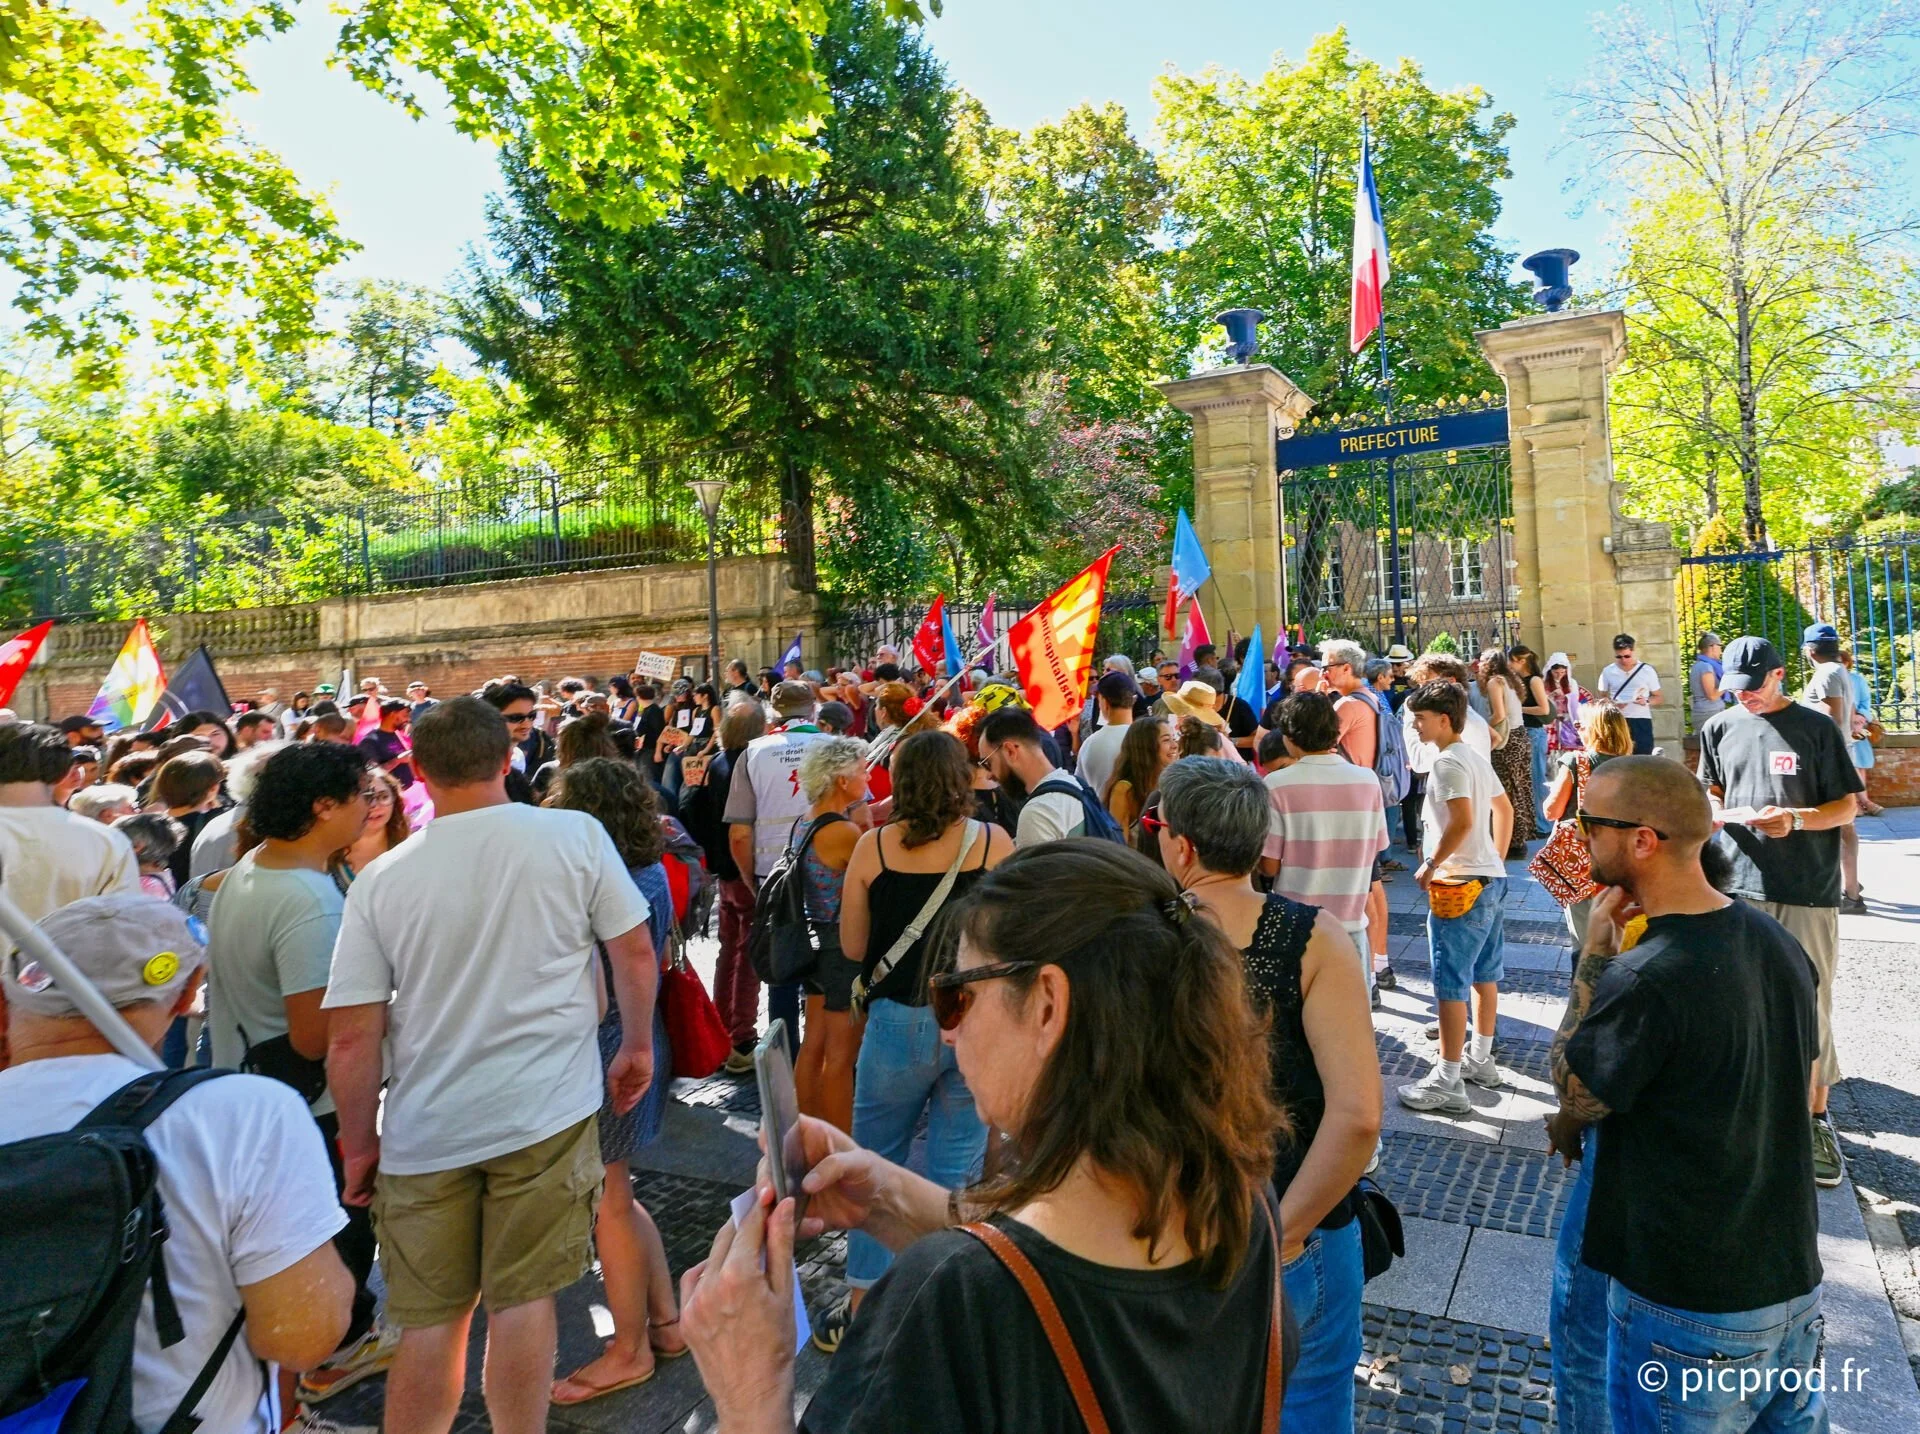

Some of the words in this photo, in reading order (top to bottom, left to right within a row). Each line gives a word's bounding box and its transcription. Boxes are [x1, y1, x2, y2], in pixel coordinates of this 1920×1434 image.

[1340, 425, 1440, 453] PREFECTURE
[1038, 607, 1076, 708] Anticapitaliste
[1774, 756, 1793, 770] FO
